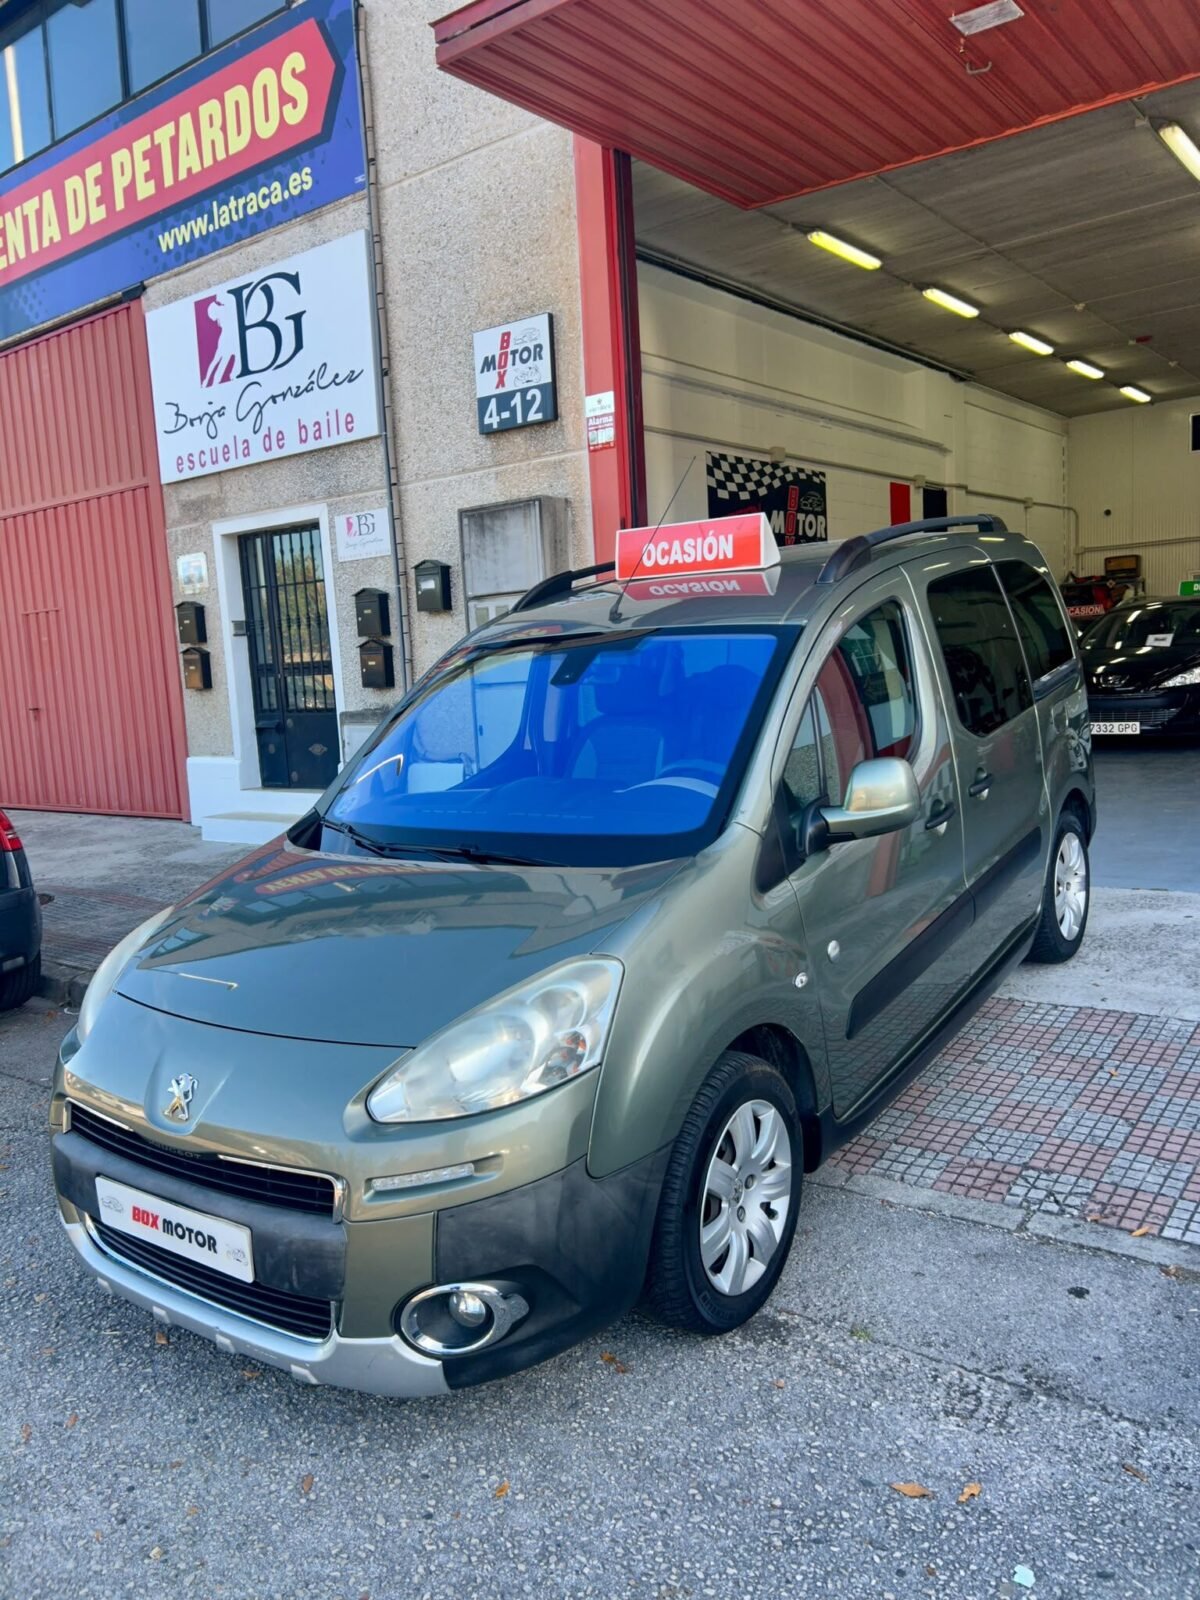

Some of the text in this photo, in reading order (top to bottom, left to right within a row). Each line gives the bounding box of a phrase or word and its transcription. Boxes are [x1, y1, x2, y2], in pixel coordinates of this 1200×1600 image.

[64, 161, 107, 236] DE
[111, 51, 309, 211] PETARDOS
[158, 166, 313, 252] www.latraca.es
[495, 331, 511, 389] BOX
[163, 362, 364, 439] Borja González
[483, 388, 543, 429] 4-12
[176, 409, 355, 473] escuela de baile
[642, 530, 734, 567] OCASIÓN
[1067, 605, 1101, 616] CASION
[1090, 723, 1137, 733] 7332 GPG
[131, 1205, 218, 1254] BOX MOTOR
